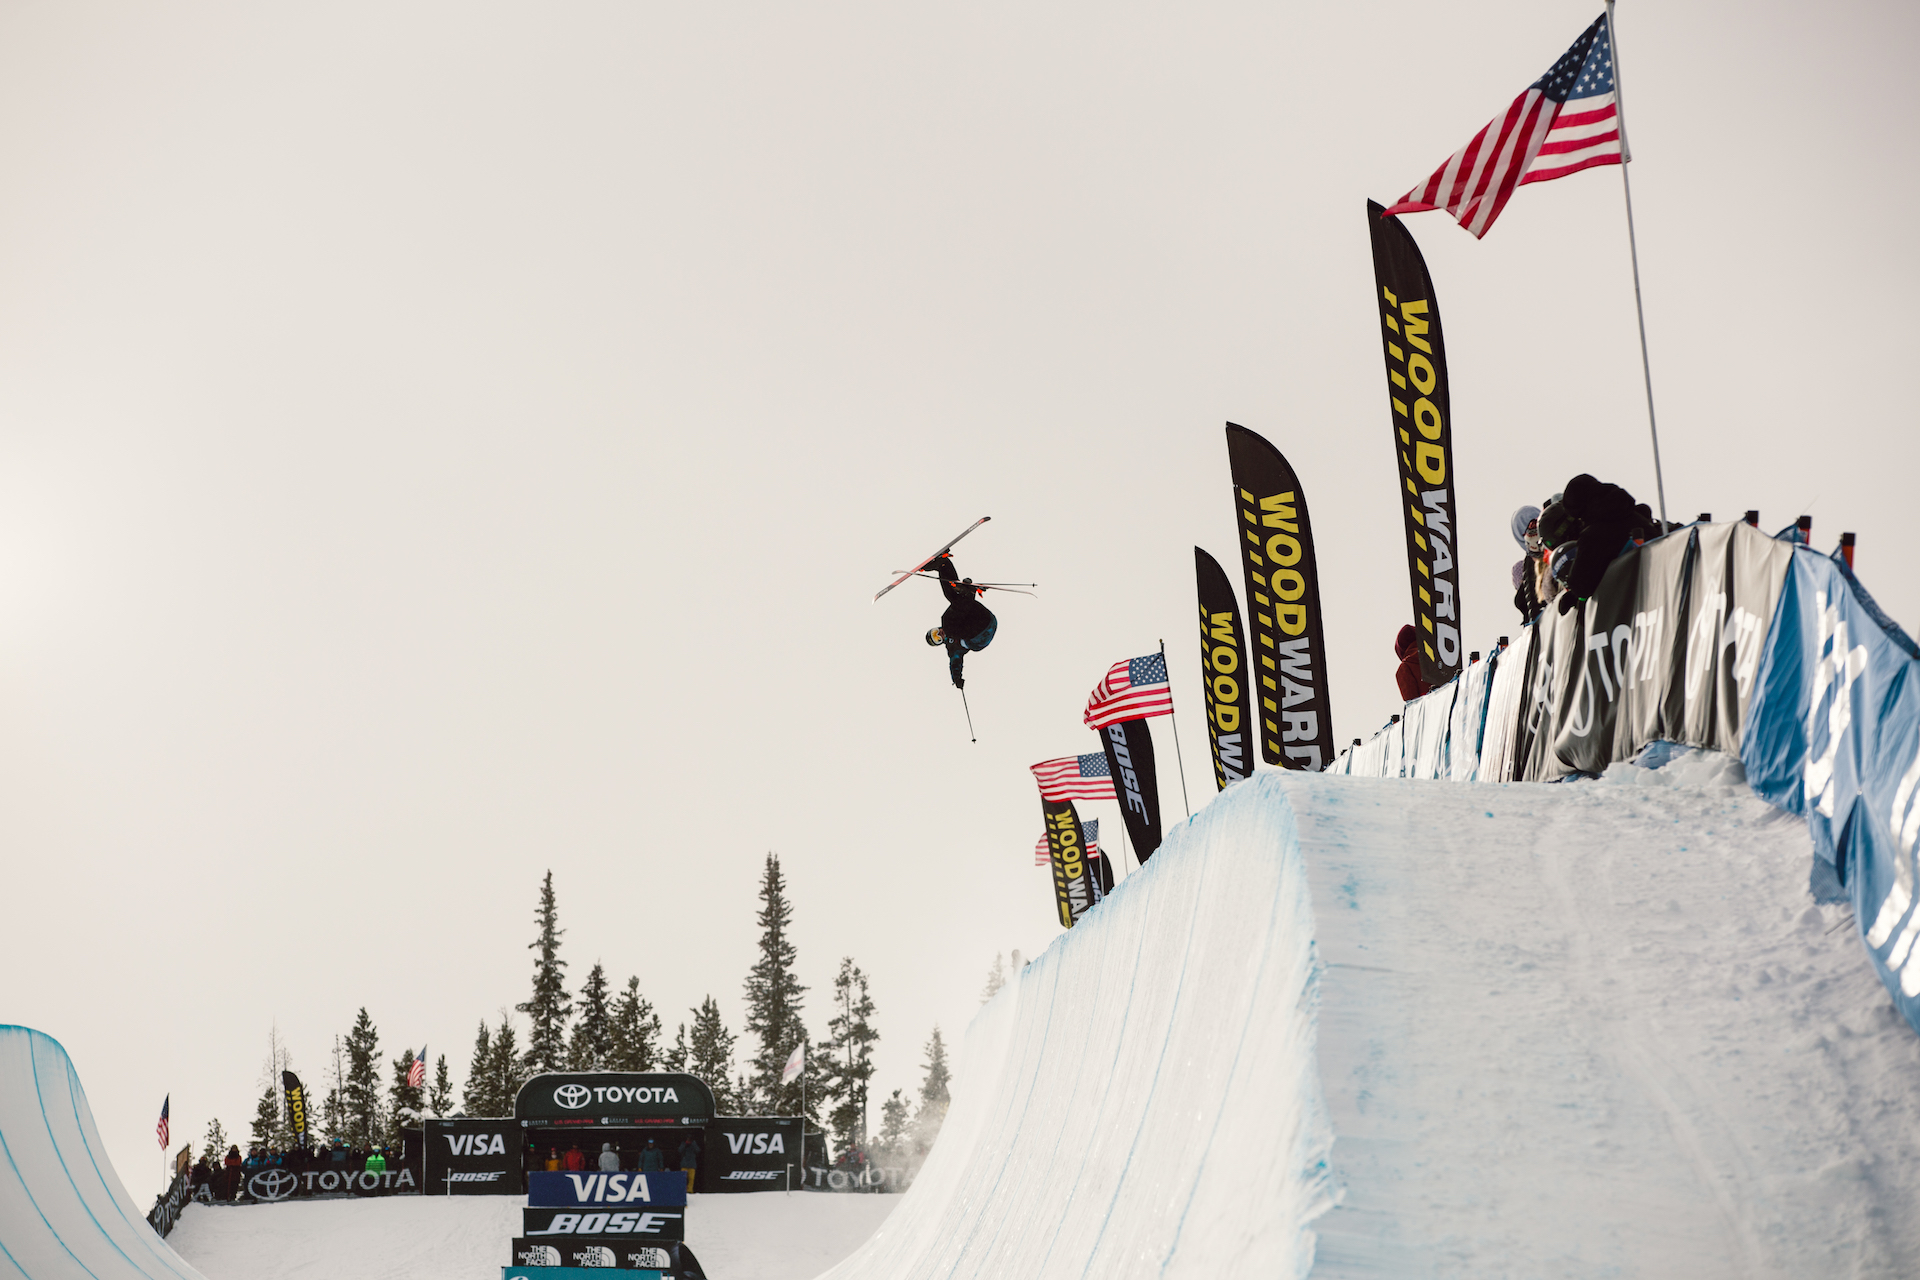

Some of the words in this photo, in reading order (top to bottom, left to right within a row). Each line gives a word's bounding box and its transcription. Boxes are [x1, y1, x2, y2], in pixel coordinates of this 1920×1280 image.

[1400, 299, 1460, 667] WOODWARD
[1259, 491, 1322, 771] WOODWARD
[1107, 723, 1150, 826] BOSE
[1055, 809, 1089, 924] WOODWA
[593, 1086, 679, 1104] TOYOTA
[291, 1086, 305, 1150] WOODW
[442, 1133, 506, 1156] VISA
[722, 1132, 785, 1154] VISA
[302, 1168, 416, 1190] TOYOTA
[441, 1170, 507, 1182] BOSE
[720, 1170, 786, 1180] BOSE
[565, 1174, 651, 1203] VISA
[526, 1212, 682, 1236] BOSE
[518, 1252, 547, 1260] NORTH
[530, 1245, 547, 1253] THE
[573, 1252, 602, 1261] NORTH
[628, 1253, 657, 1261] NORTH
[525, 1259, 547, 1267] FACE
[580, 1260, 601, 1268] FACE
[635, 1260, 657, 1268] FACE
